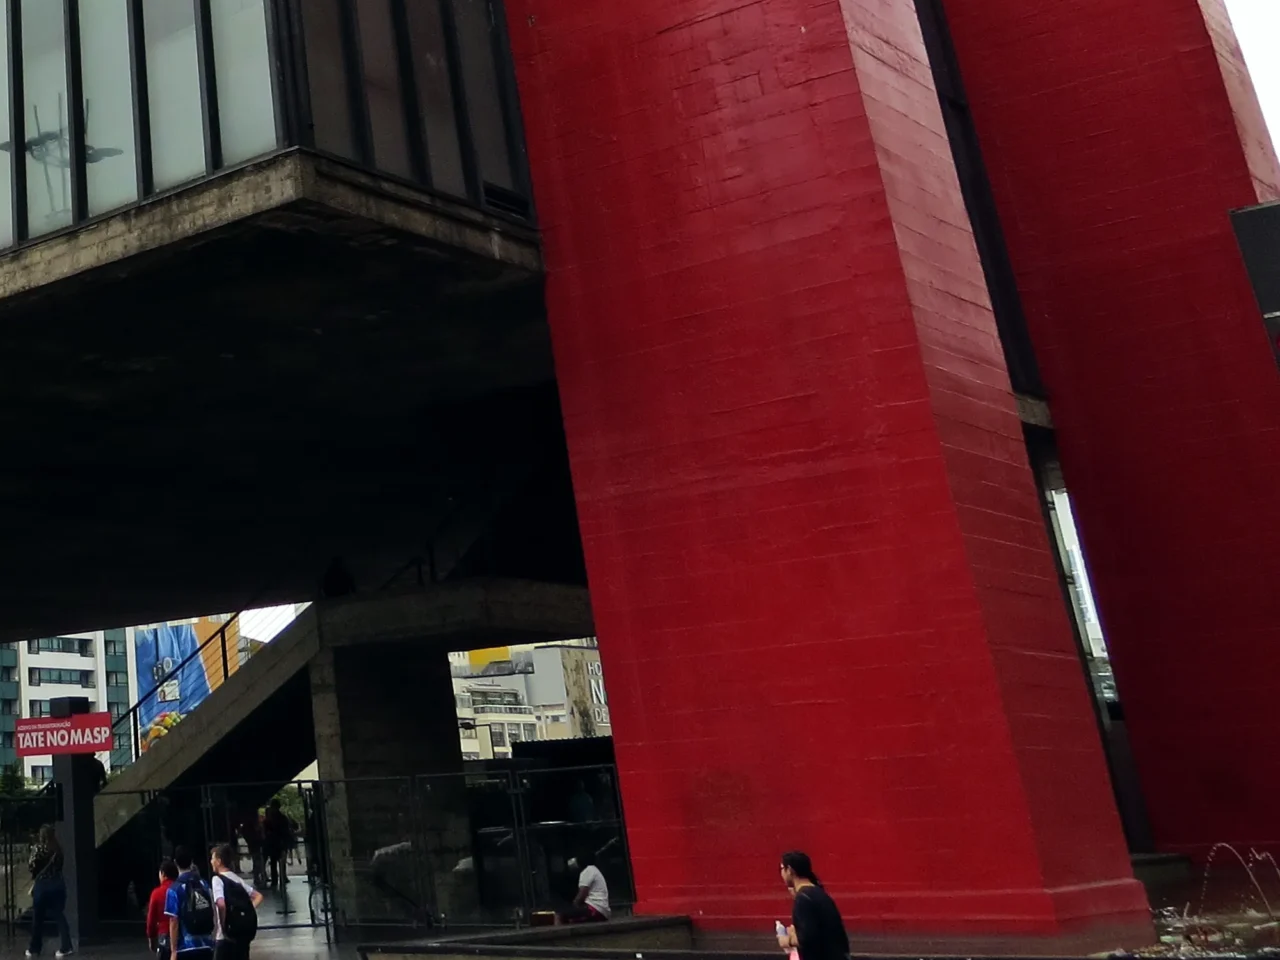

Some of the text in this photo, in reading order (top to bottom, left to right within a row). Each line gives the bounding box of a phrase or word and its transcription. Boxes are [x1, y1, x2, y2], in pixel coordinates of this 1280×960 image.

[18, 726, 110, 748] TATE NO MASP
